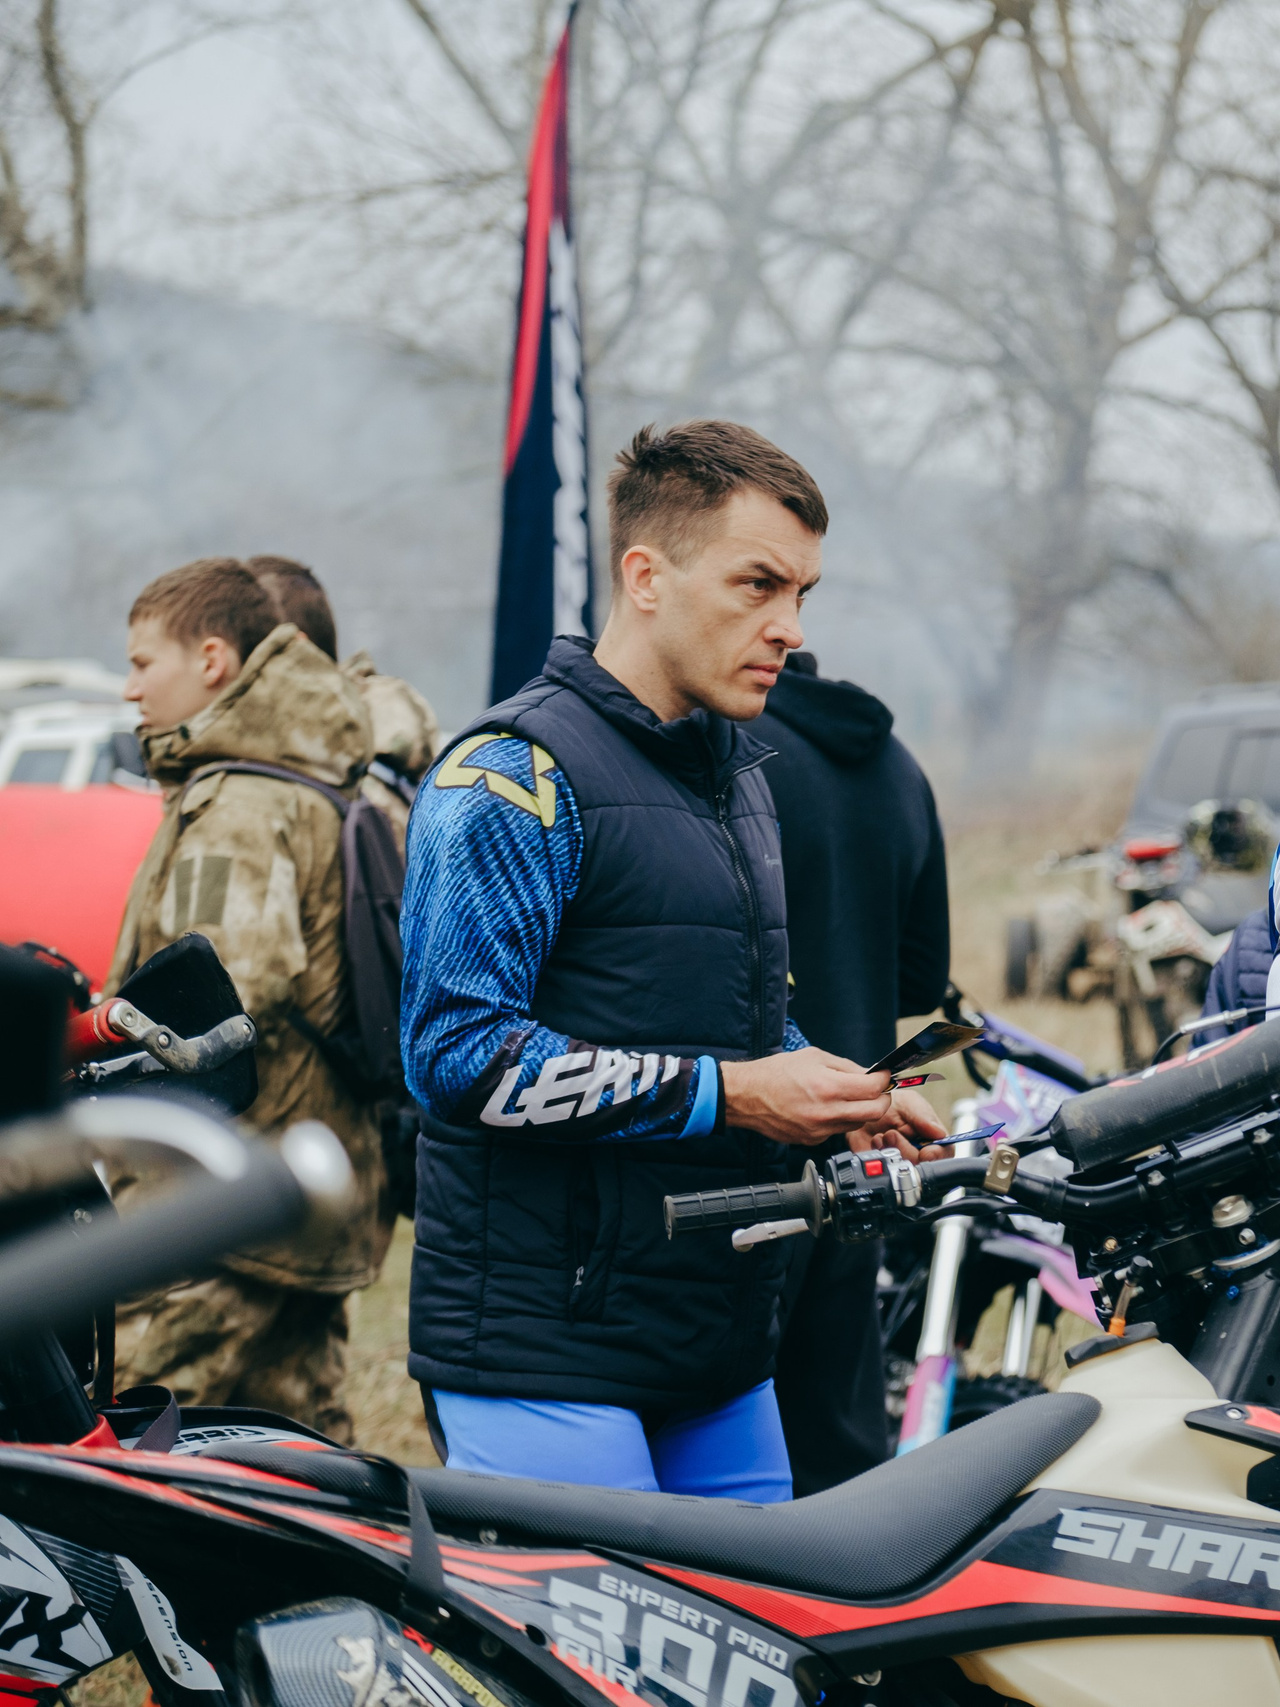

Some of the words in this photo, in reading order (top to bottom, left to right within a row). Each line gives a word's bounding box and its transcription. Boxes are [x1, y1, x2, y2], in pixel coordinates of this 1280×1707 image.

[142, 1573, 193, 1672] SPENSION
[549, 1576, 799, 1707] 300
[556, 1634, 638, 1694] AIR
[599, 1571, 722, 1636] EXPERT
[726, 1626, 789, 1670] PRO
